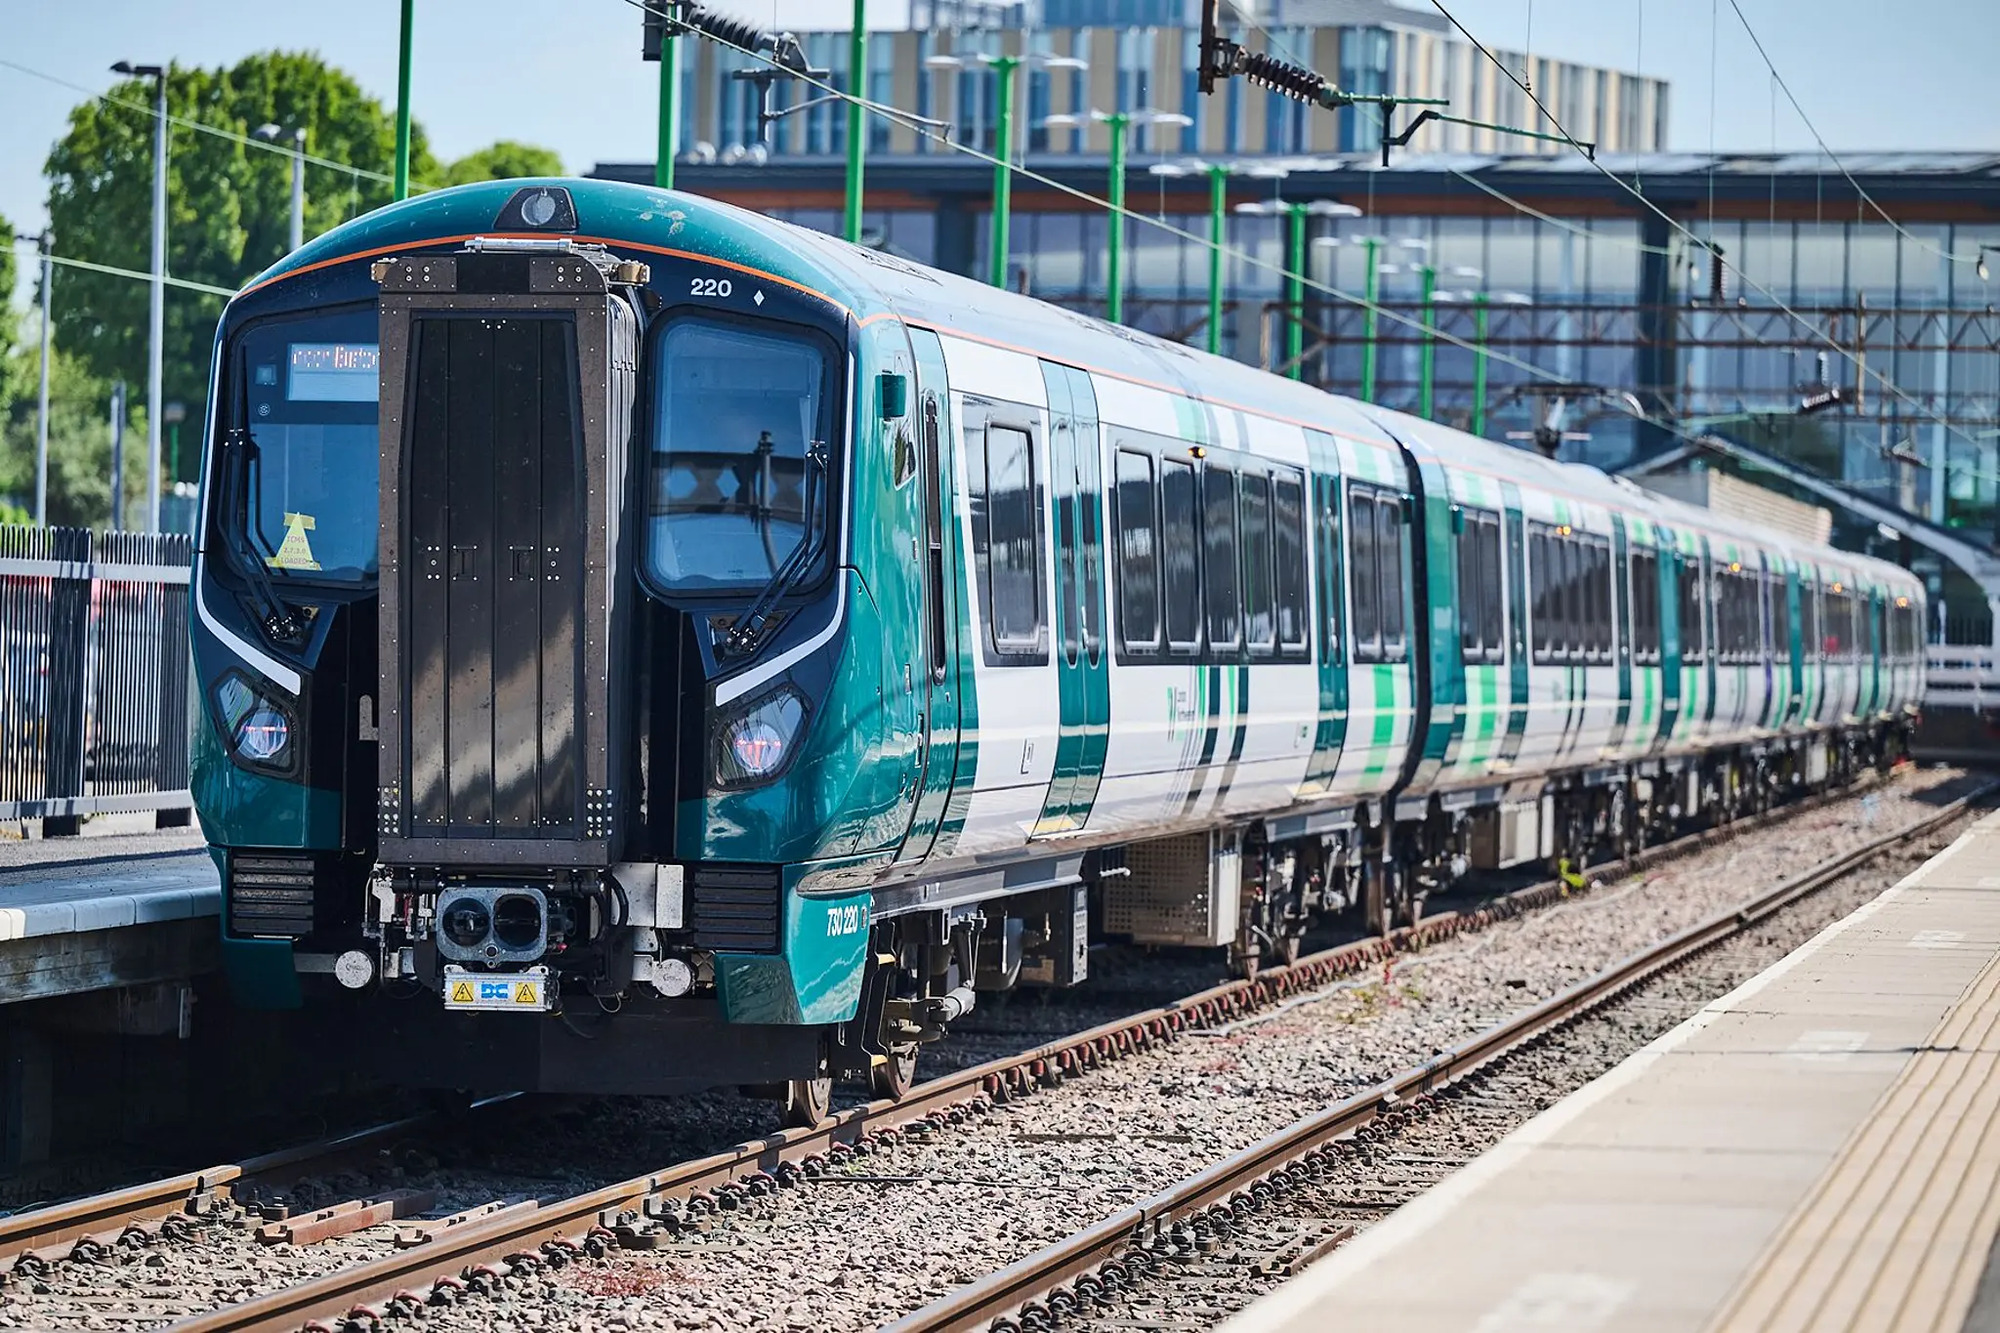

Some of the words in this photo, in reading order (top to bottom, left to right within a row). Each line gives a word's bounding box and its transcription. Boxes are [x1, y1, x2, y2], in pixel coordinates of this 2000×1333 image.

[690, 278, 732, 297] 220
[827, 907, 843, 936] 730
[843, 905, 858, 933] 220
